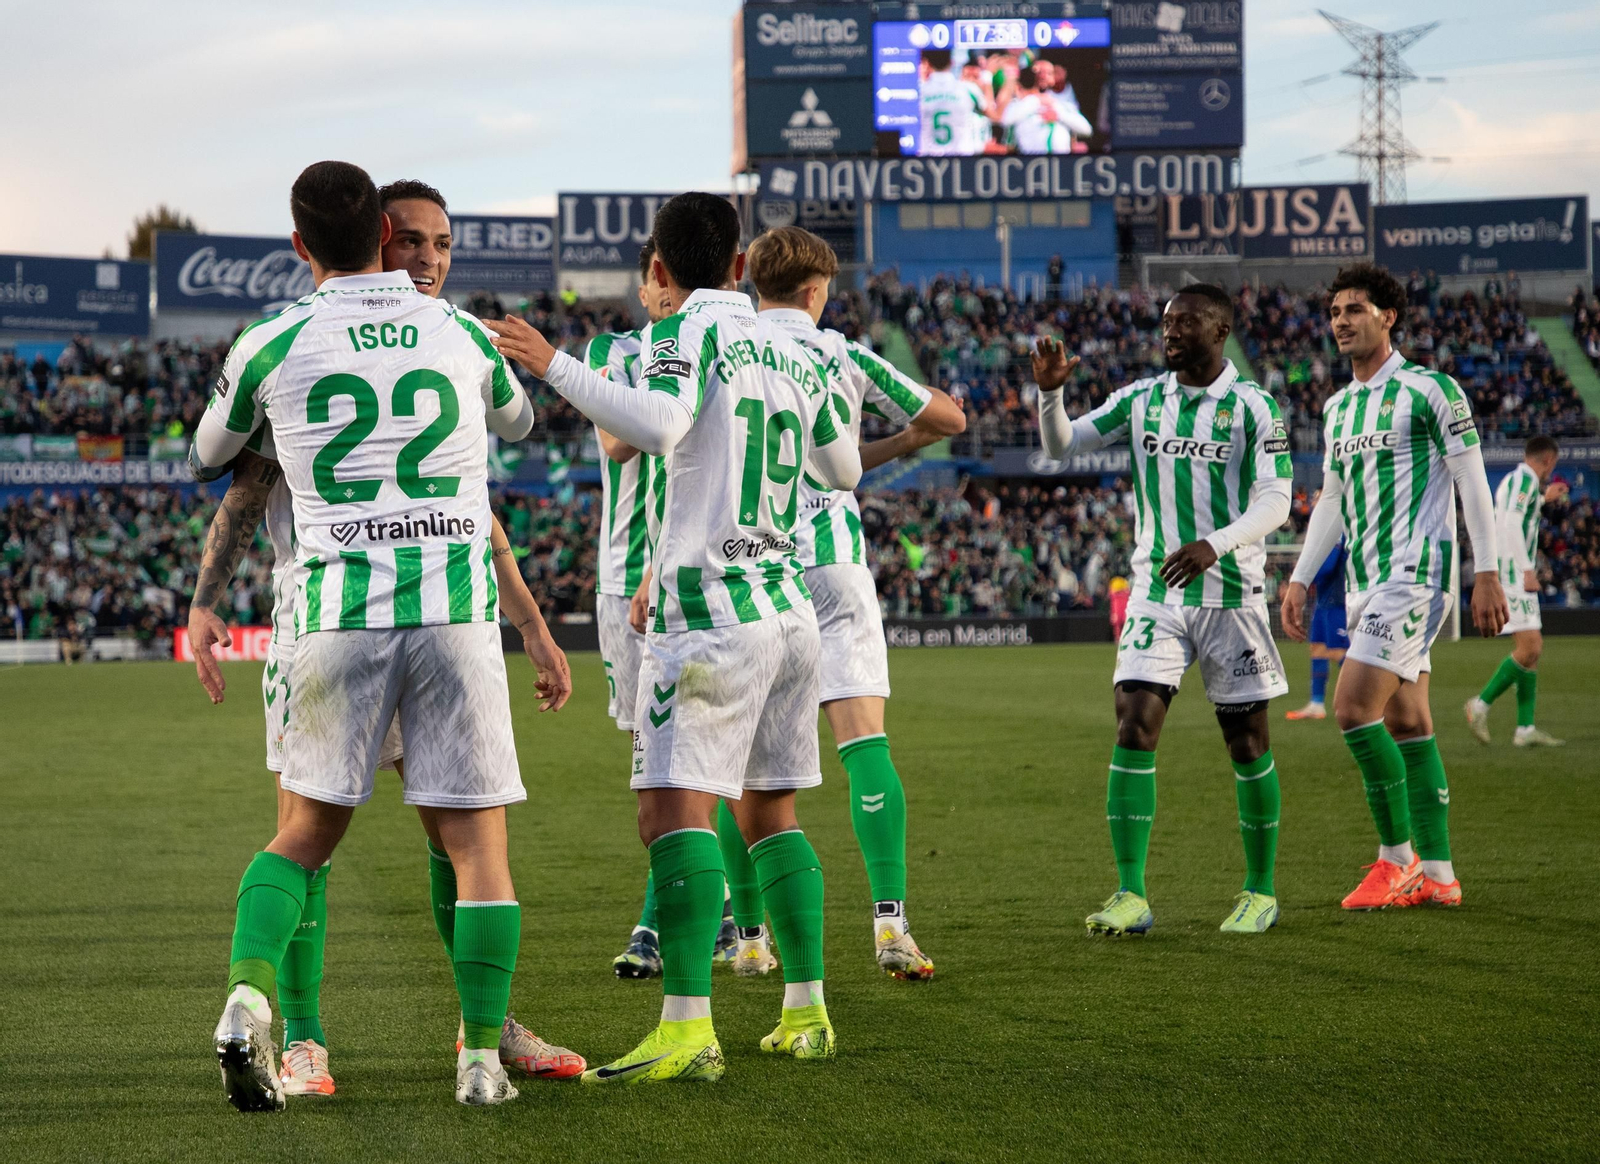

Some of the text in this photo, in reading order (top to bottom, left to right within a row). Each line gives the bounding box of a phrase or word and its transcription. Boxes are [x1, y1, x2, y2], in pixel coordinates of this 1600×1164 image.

[932, 24, 950, 48] 0
[1034, 22, 1052, 47] 0
[933, 111, 951, 145] 5
[1165, 187, 1365, 239] LUJISA
[486, 222, 553, 249] RED
[1290, 237, 1366, 256] IMELCO
[1383, 226, 1473, 248] vamos
[347, 323, 419, 353] ISCO
[642, 363, 689, 376] REVEL
[716, 339, 822, 402] C.HERÁNDEZ
[306, 368, 462, 506] 22
[1265, 441, 1289, 451] REV
[1344, 432, 1399, 454] GREE
[1162, 439, 1235, 461] GREE
[0, 461, 123, 484] TODESGUACES
[125, 461, 149, 484] DE
[735, 396, 803, 533] 19
[364, 511, 476, 542] trainline
[886, 622, 1033, 647] Kia en Madrid.
[1120, 616, 1157, 651] 23
[1368, 620, 1393, 633] AUS
[1233, 663, 1276, 677] GLOBAL
[1250, 655, 1270, 667] AUS
